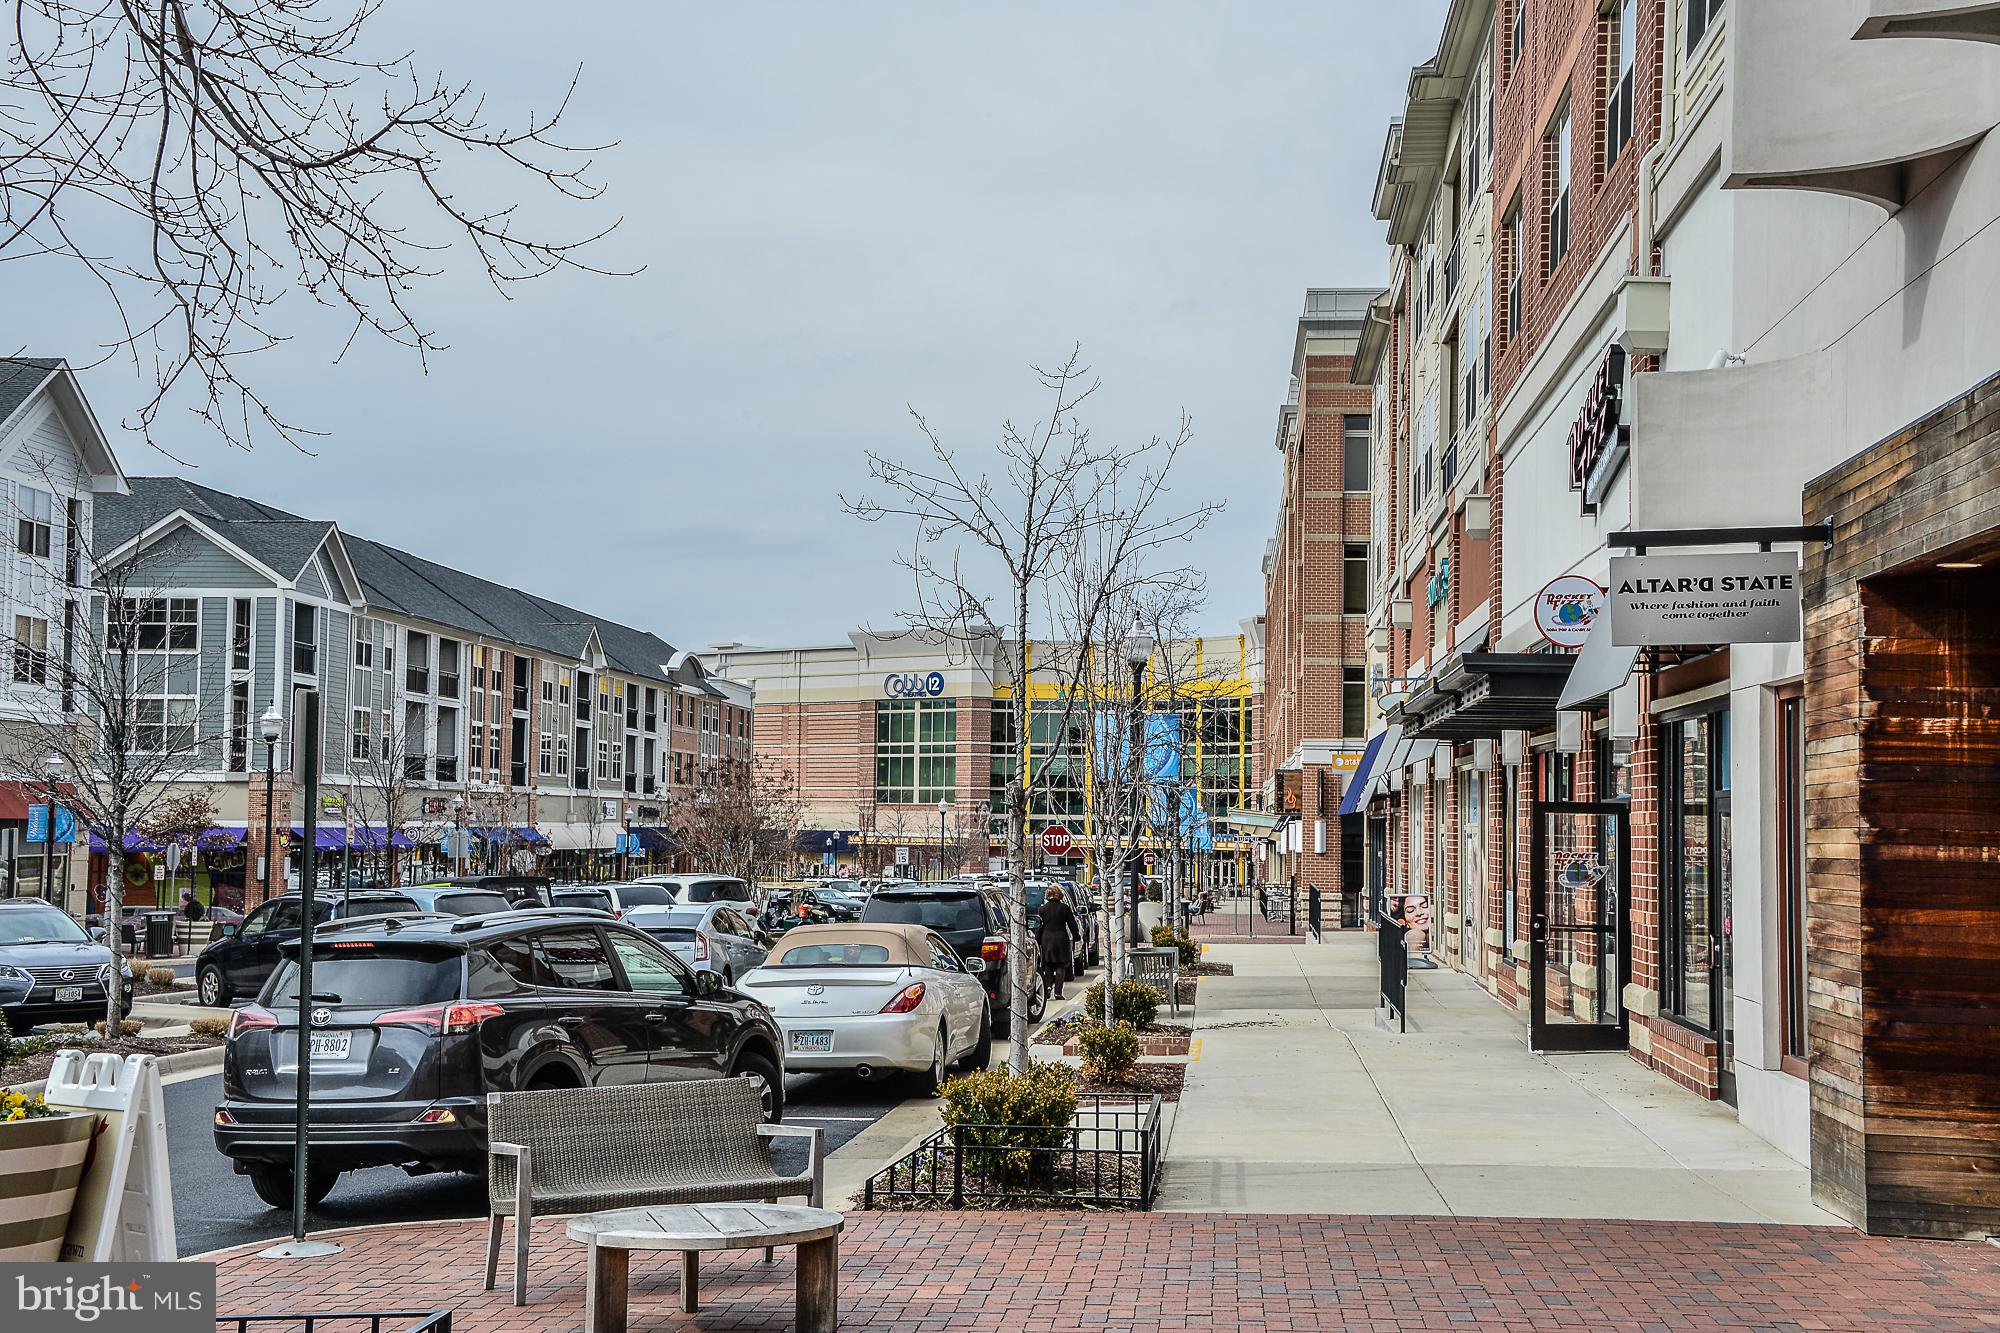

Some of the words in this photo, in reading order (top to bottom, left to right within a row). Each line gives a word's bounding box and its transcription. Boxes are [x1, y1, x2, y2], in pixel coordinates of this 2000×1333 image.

[1721, 575, 1793, 592] STATE
[1542, 593, 1594, 605] ROCKET
[1630, 602, 1670, 611] Where
[1672, 600, 1719, 610] fashion
[1722, 599, 1747, 608] and
[1749, 598, 1781, 609] faith
[1697, 610, 1750, 621] together
[884, 673, 925, 698] Cobb
[928, 676, 940, 691] 12
[1043, 834, 1070, 847] STOP
[1552, 851, 1598, 864] ROCKET
[311, 1038, 348, 1052] PH-8802
